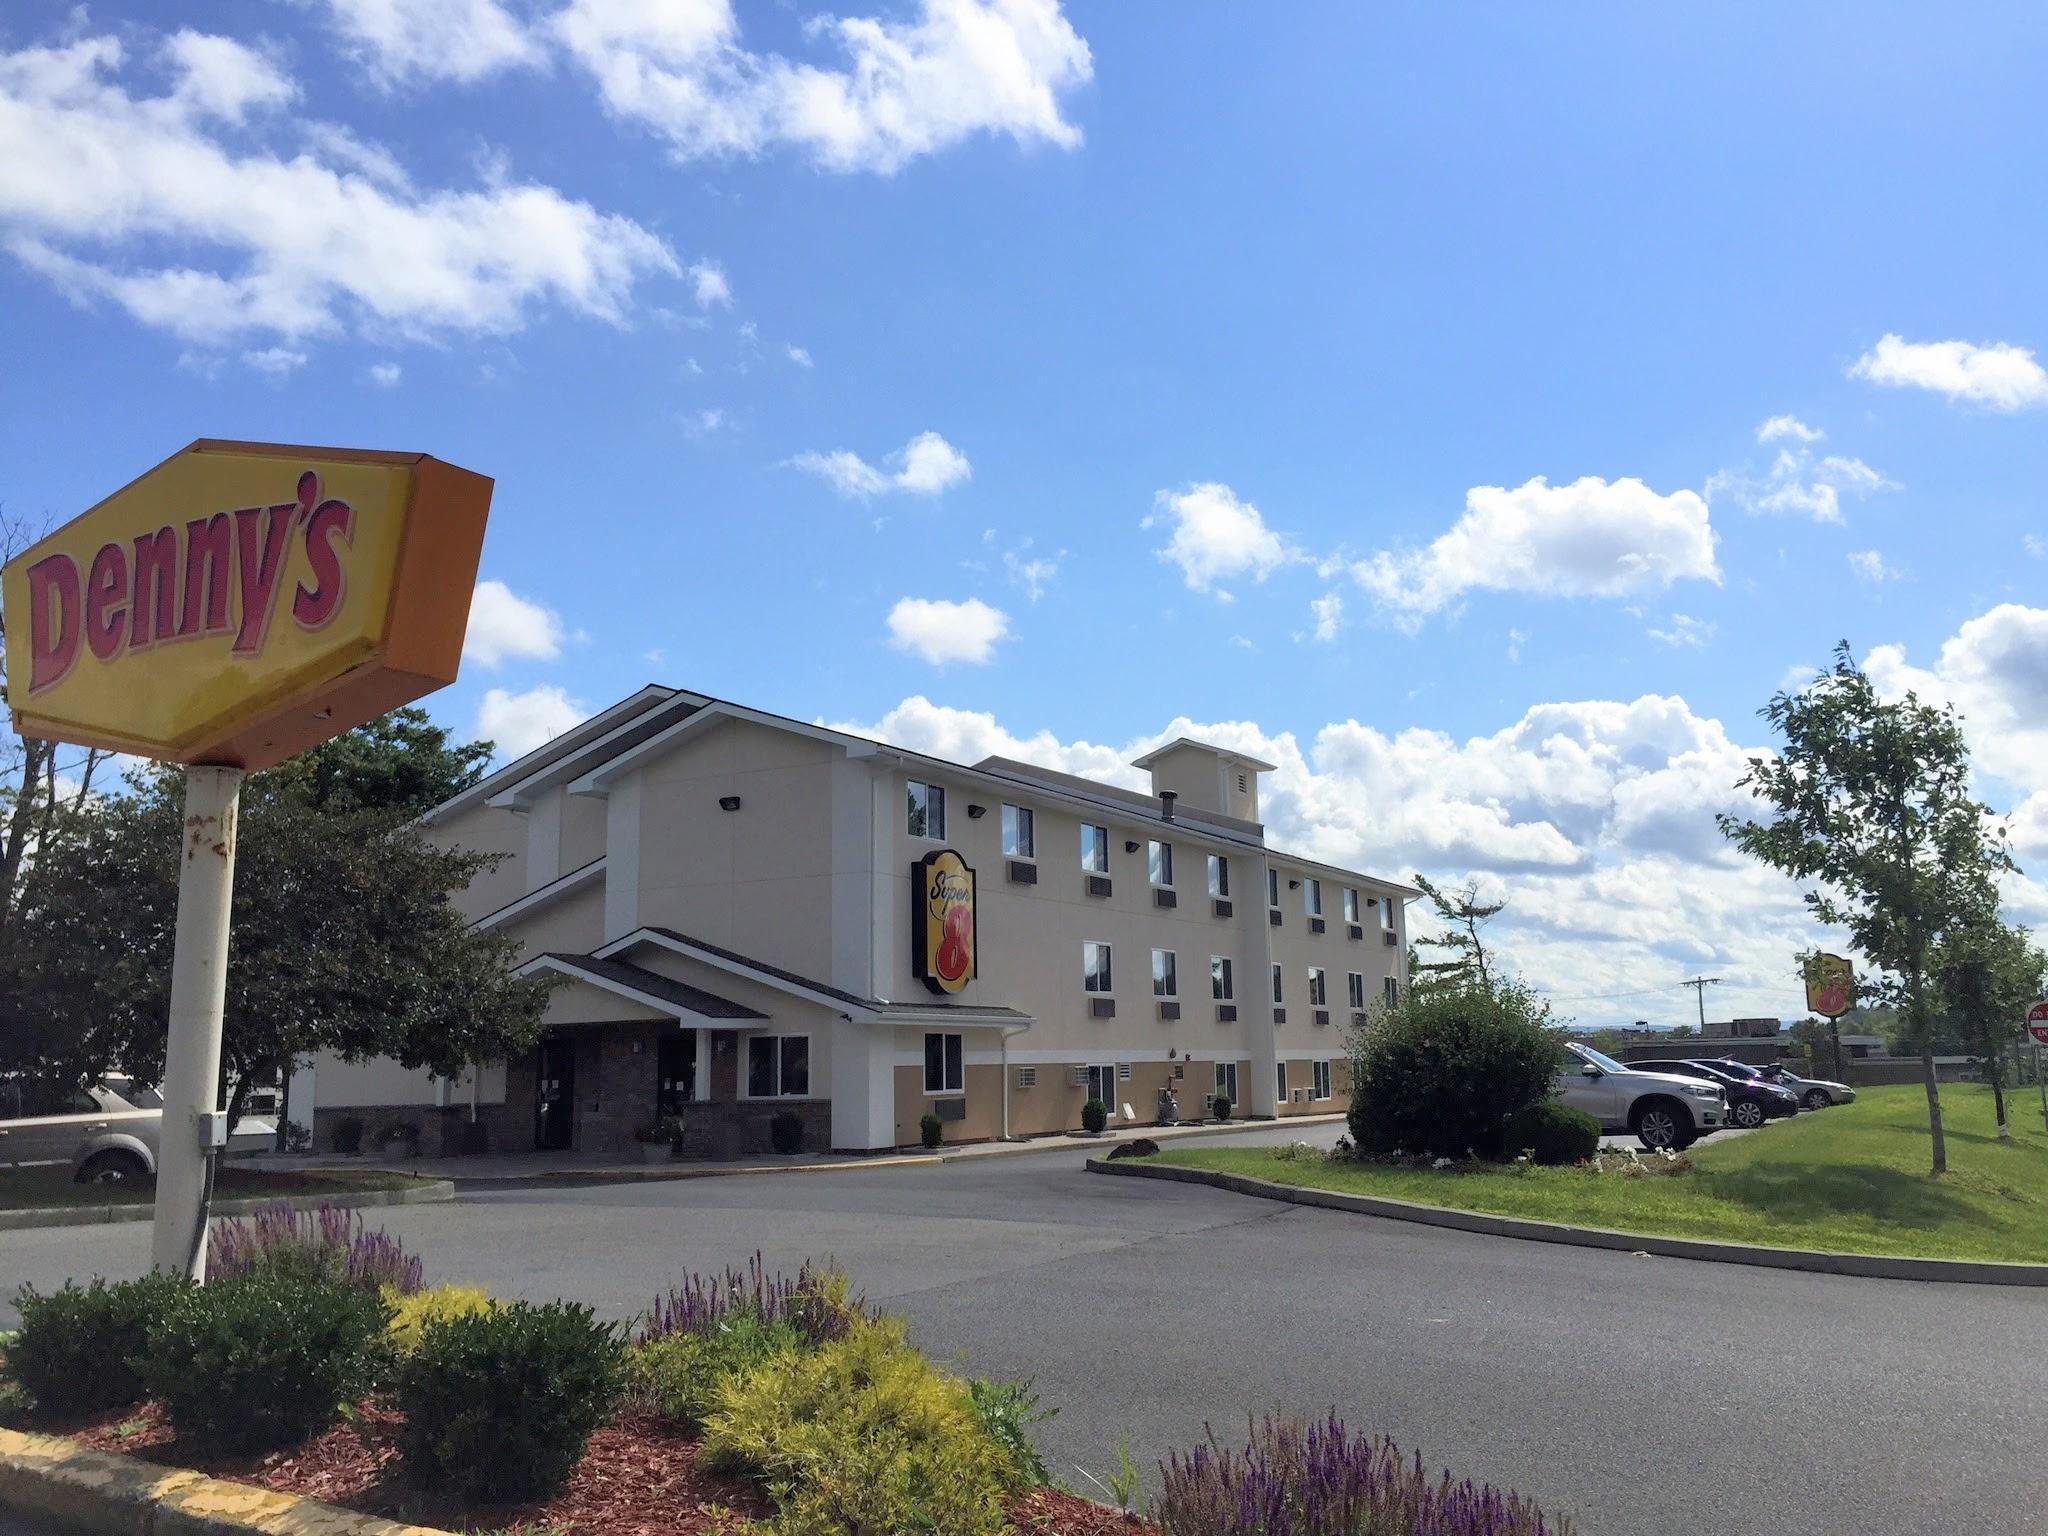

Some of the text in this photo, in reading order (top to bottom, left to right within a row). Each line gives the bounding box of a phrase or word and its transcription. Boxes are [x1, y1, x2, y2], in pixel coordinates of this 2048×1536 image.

[26, 469, 358, 698] Denny's
[930, 870, 970, 916] Super
[935, 905, 972, 982] 8
[2032, 1010, 2043, 1018] DO
[2037, 1029, 2048, 1037] EN
